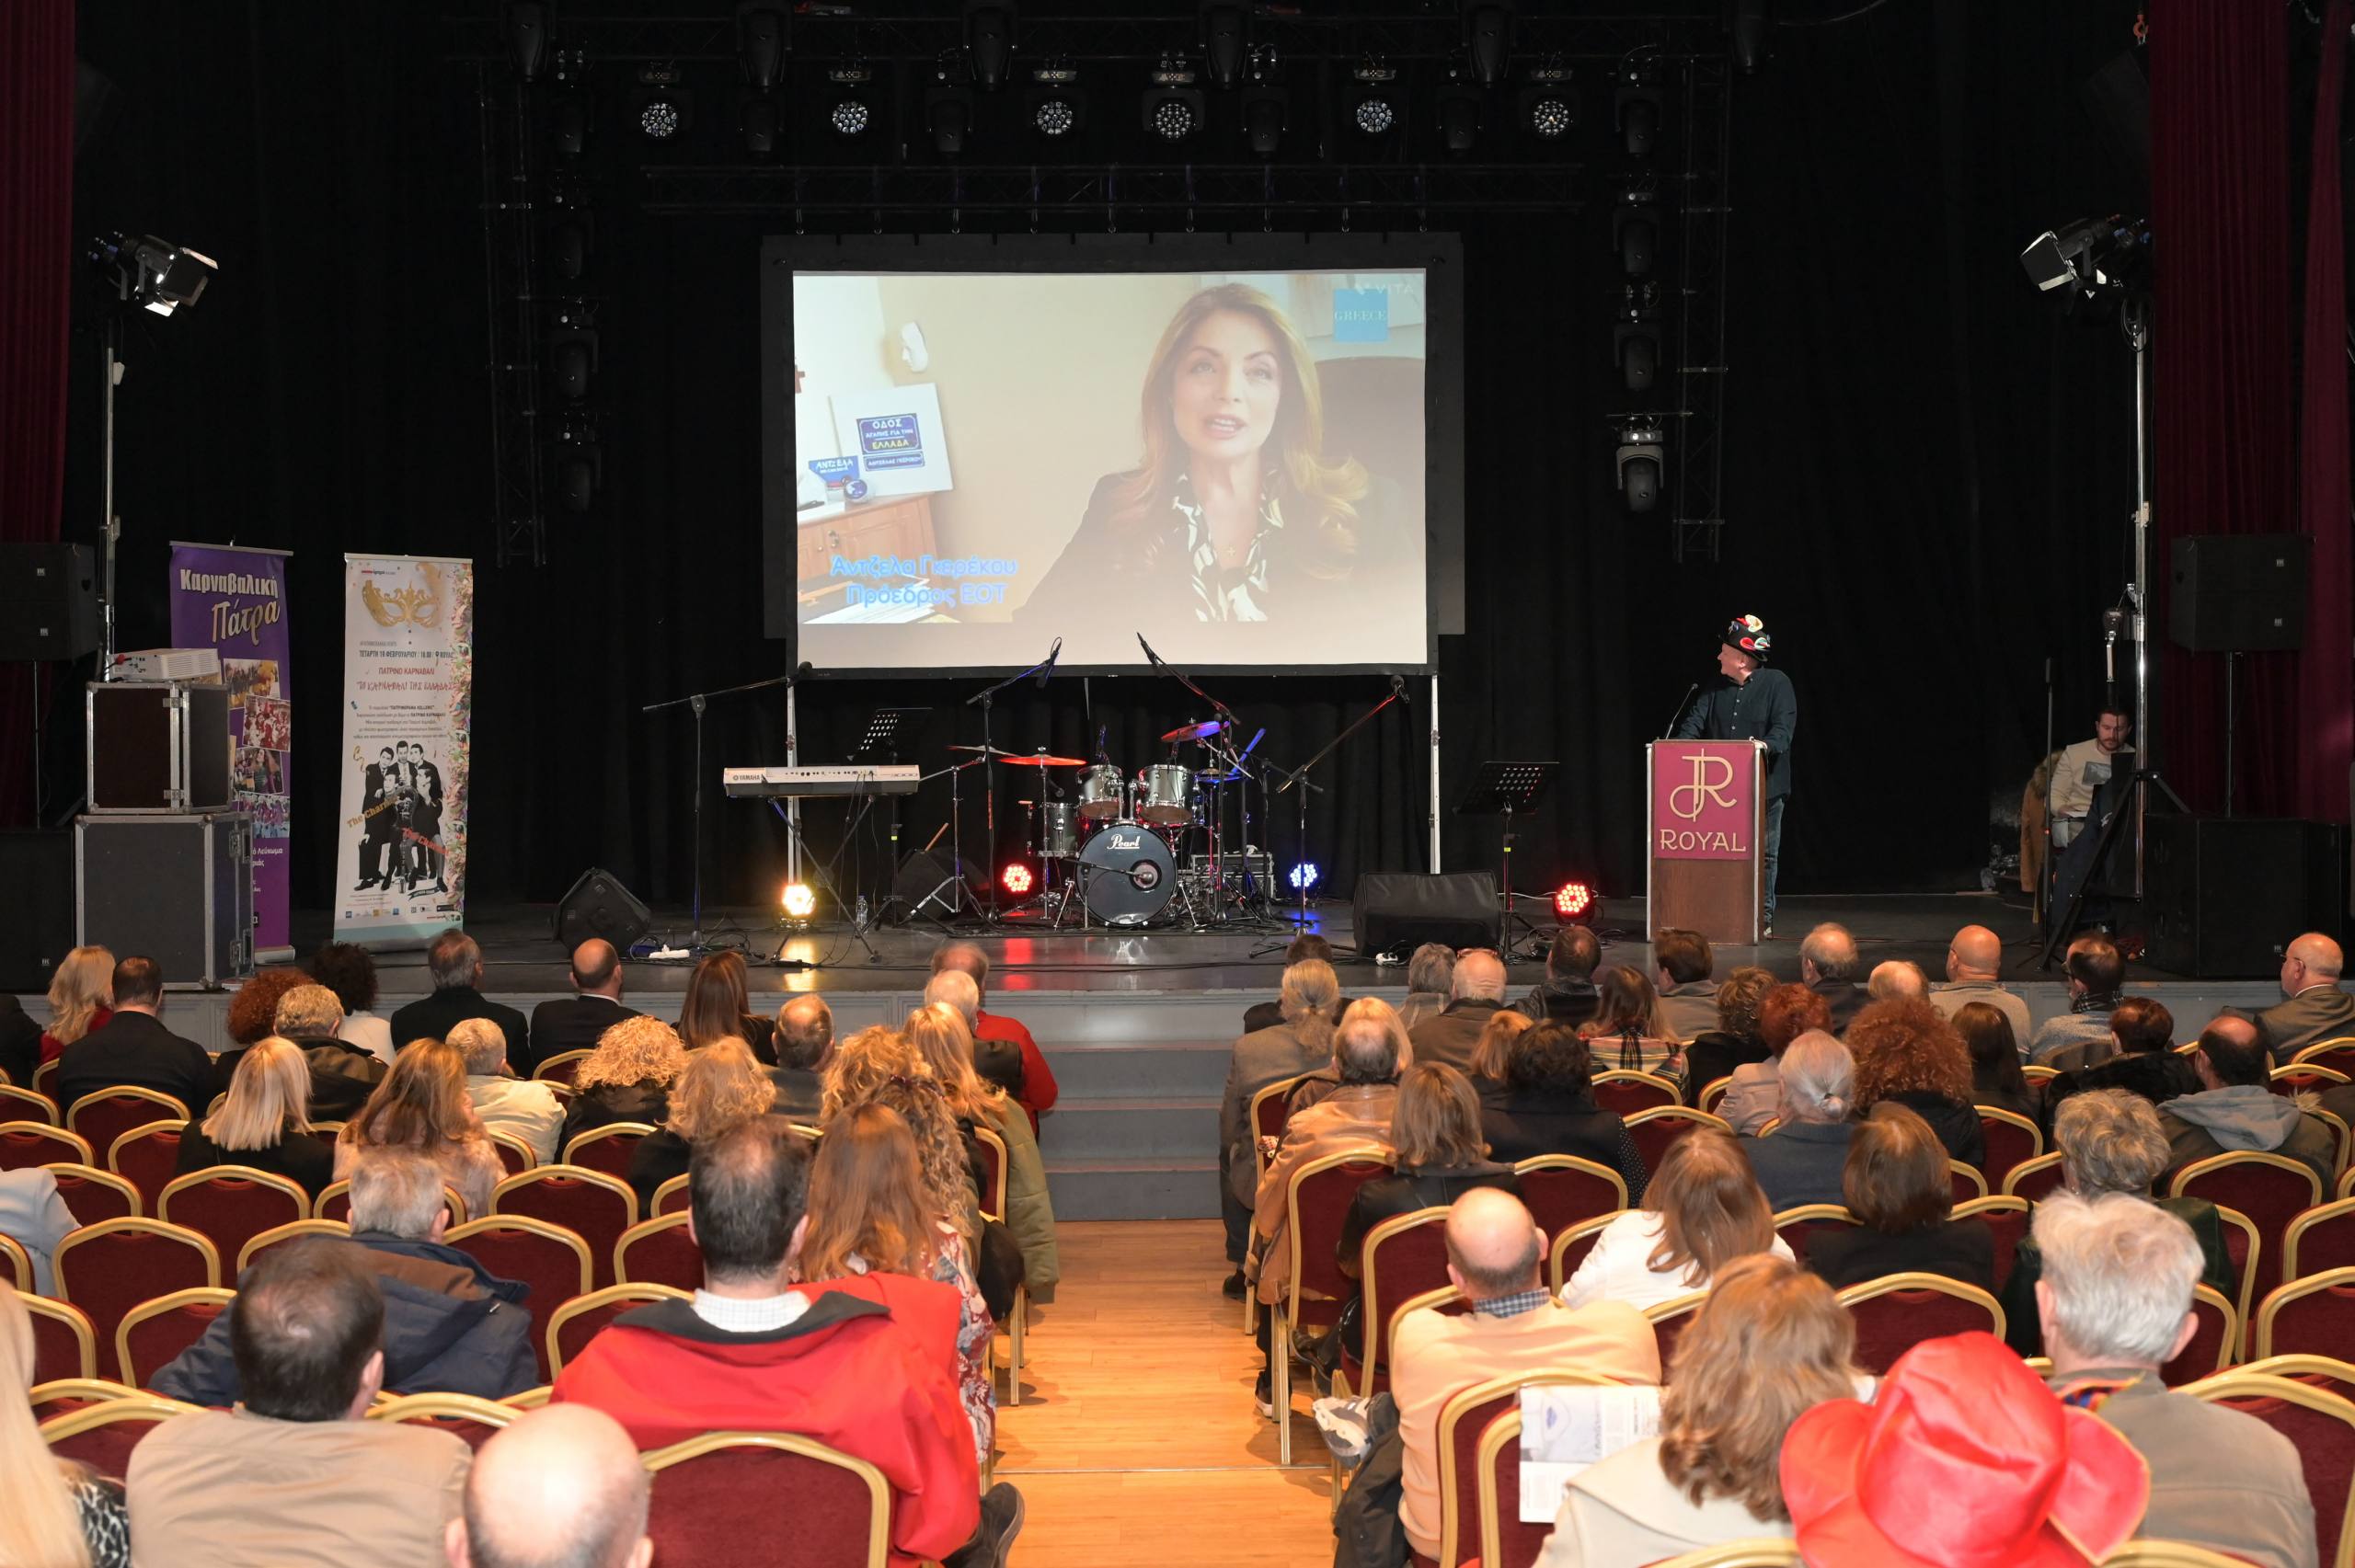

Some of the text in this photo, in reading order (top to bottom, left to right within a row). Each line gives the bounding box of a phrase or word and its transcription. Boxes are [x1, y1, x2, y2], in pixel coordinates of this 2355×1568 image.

[1334, 311, 1387, 321] GREECE
[872, 418, 902, 429] ΟΔΟΣ
[872, 440, 910, 450] ΕΛΛΑΔΑ
[831, 554, 1019, 578] Άντζελα Γκερέκου
[179, 568, 279, 599] Καρναβαλική
[846, 583, 1007, 608] Πρόεδρος ΕΟΤ
[211, 598, 281, 646] Πάτρα
[378, 667, 435, 676] ΠΑΤΡΙΝΟ ΚΑΡΝΑΒΑΛΙ
[1107, 833, 1141, 850] Pearl
[1660, 829, 1747, 852] ROYAL
